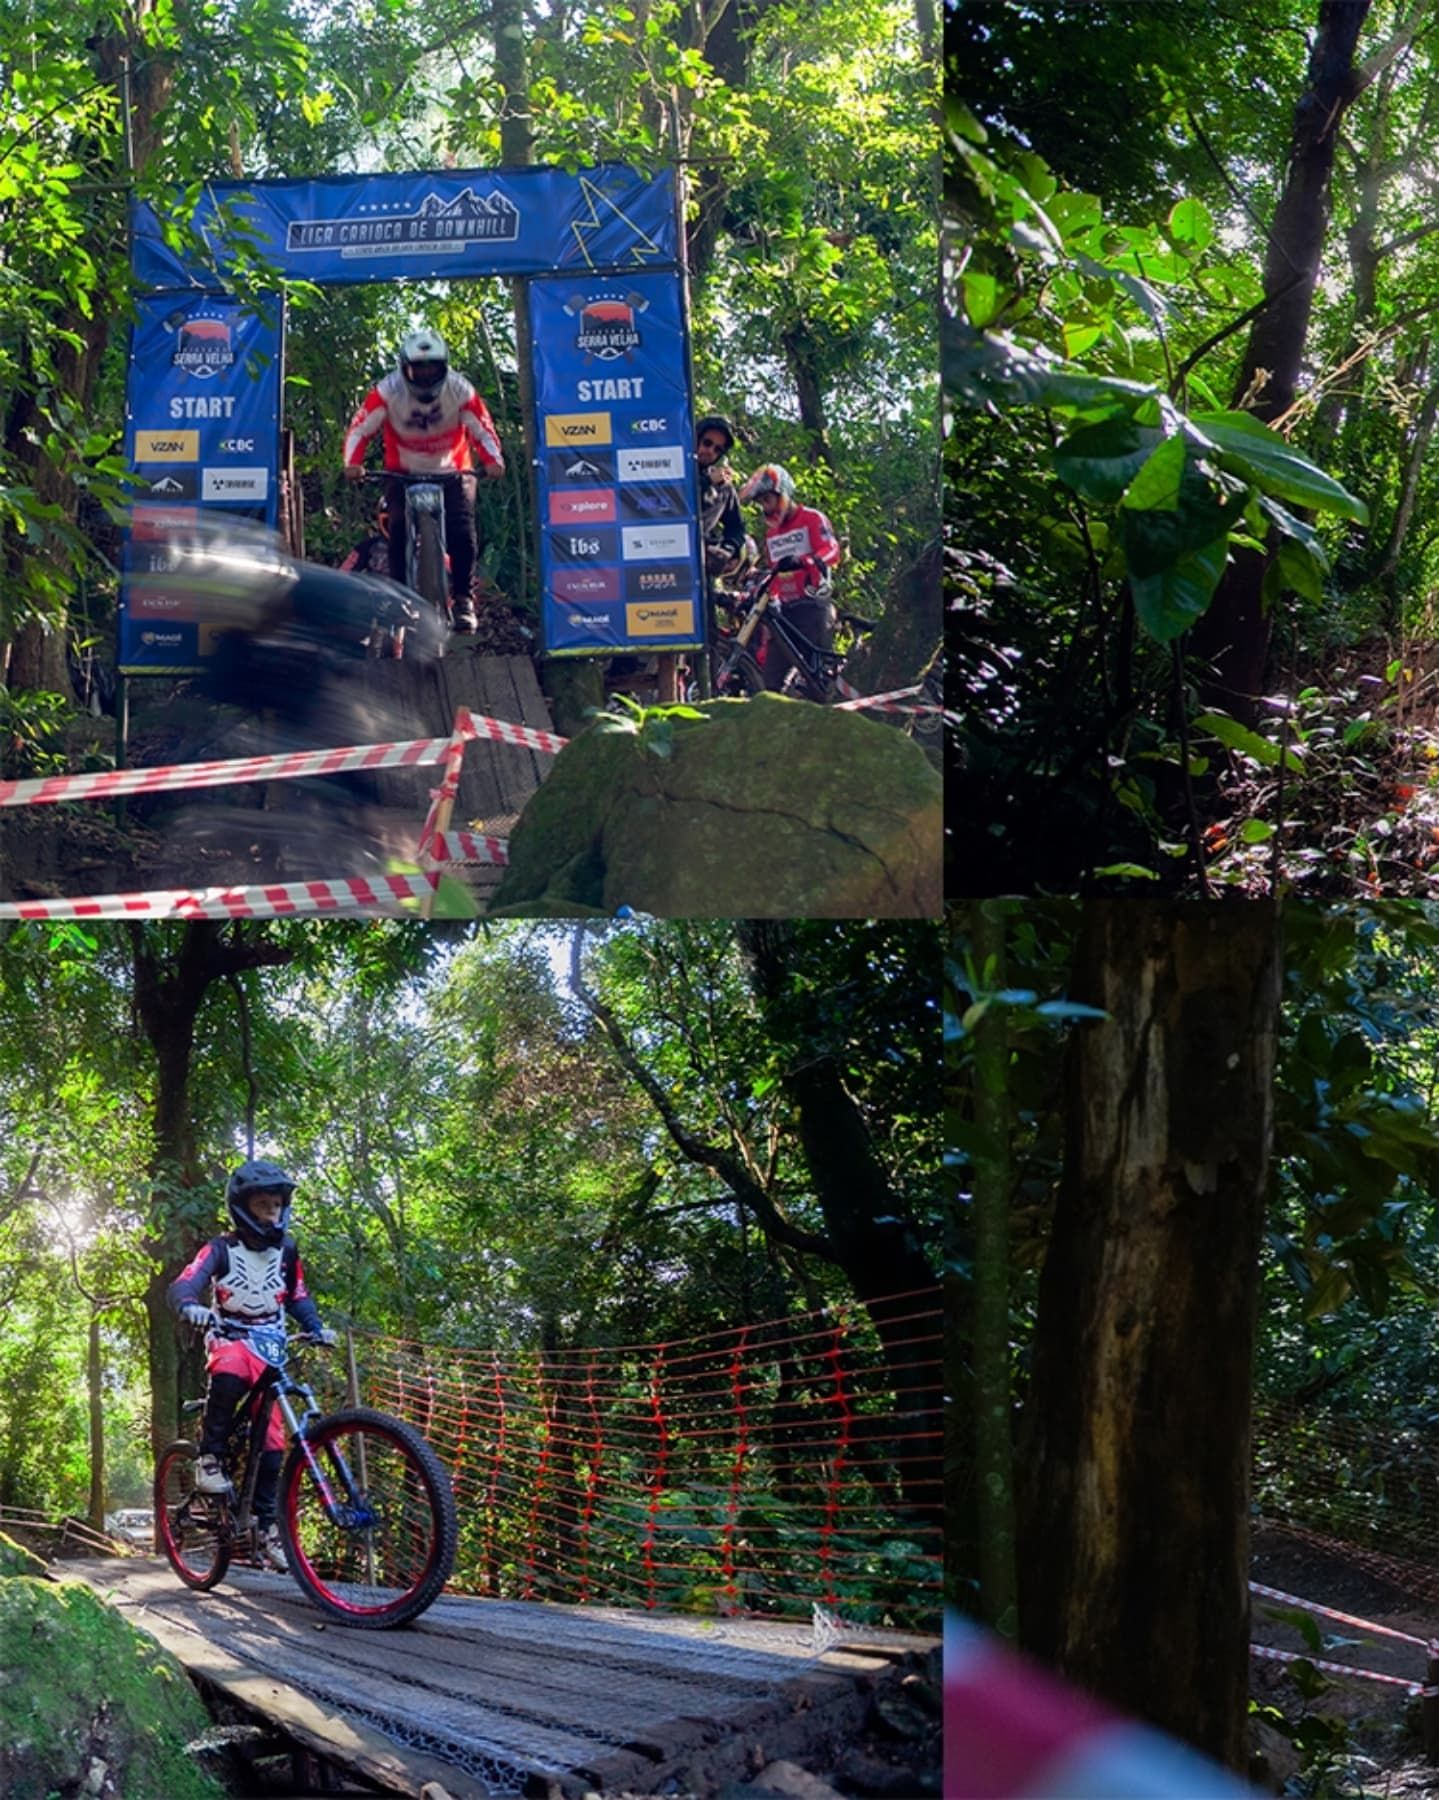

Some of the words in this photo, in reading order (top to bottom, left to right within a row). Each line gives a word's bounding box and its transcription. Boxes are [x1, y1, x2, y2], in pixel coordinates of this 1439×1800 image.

[301, 227, 334, 244] LIGA
[339, 222, 402, 242] CARIOCA
[410, 220, 427, 239] DE
[435, 217, 507, 237] DOWNHILL
[577, 335, 608, 349] SERRA
[609, 333, 640, 347] VELHA
[577, 377, 645, 402] START
[169, 396, 236, 419] START
[639, 418, 667, 432] CBC
[227, 439, 254, 452] CBC
